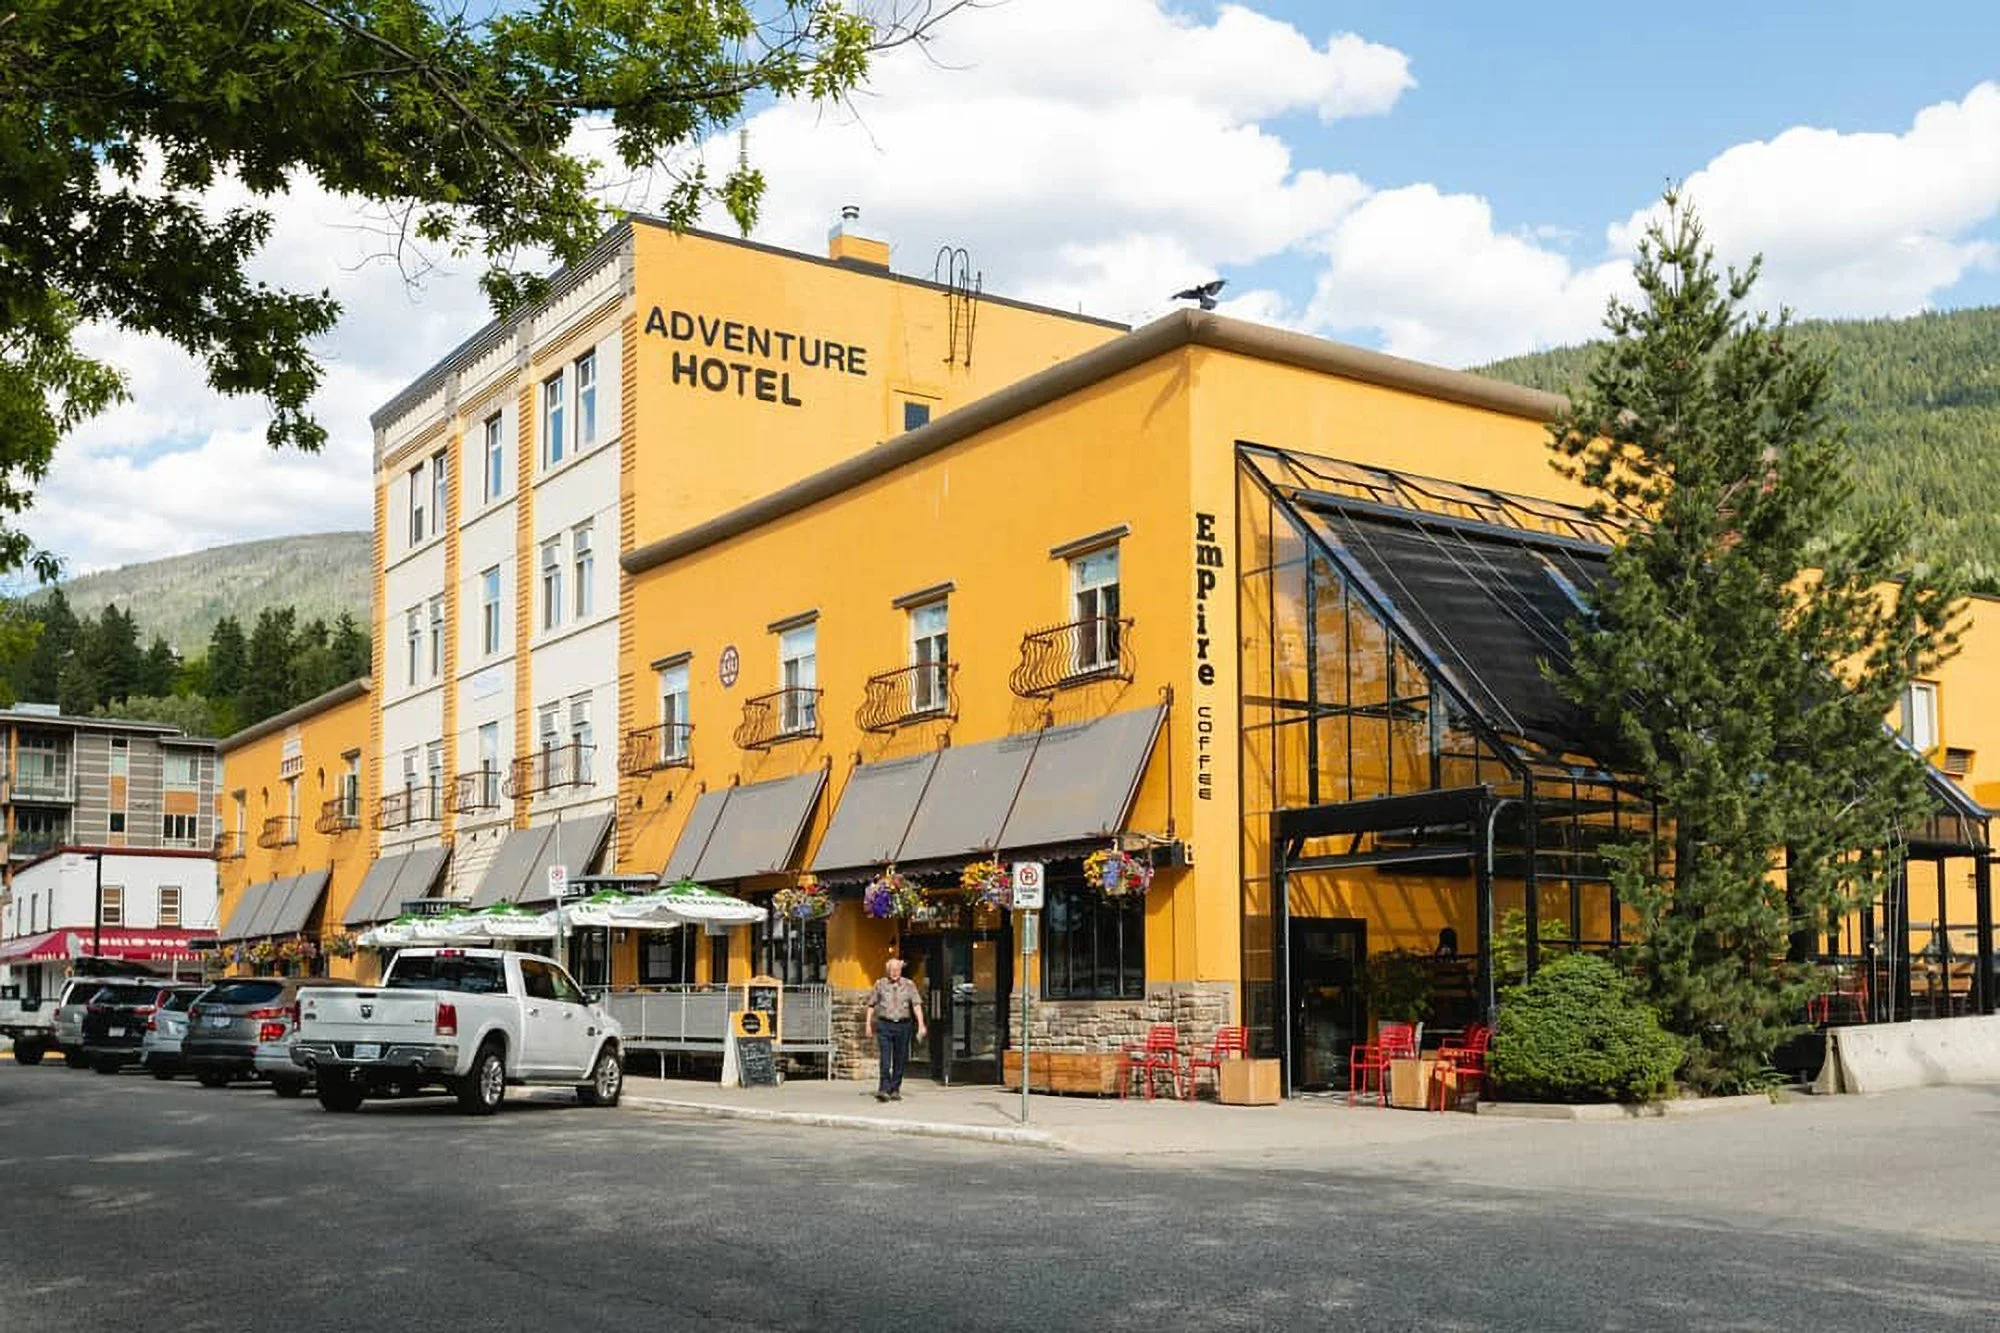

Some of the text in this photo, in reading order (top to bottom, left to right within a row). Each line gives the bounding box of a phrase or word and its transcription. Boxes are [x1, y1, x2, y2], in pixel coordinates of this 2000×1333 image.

[644, 305, 867, 376] ADVENTURE
[672, 351, 802, 407] HOTEL
[1195, 511, 1224, 687] Empire
[1197, 706, 1213, 801] COFFEE
